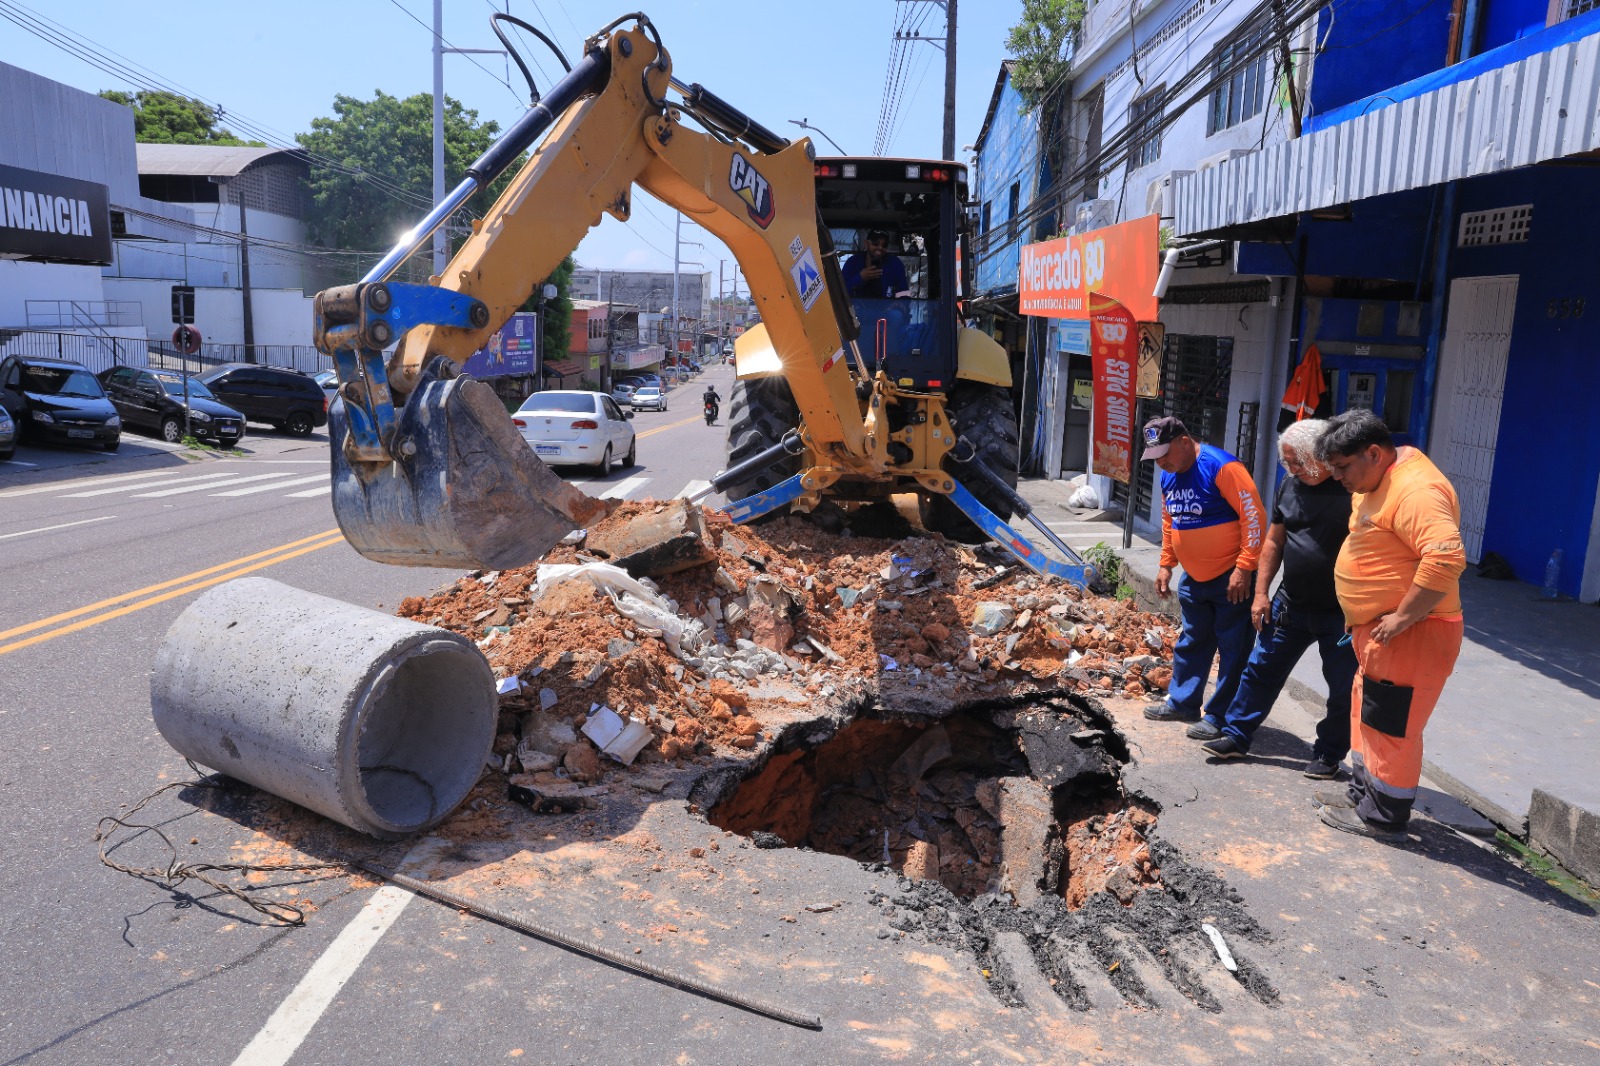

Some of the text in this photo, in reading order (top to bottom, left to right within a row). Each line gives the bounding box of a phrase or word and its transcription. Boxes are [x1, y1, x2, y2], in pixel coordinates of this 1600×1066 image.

[730, 153, 768, 213] CAT
[0, 186, 93, 237] INANCIA
[1023, 235, 1105, 292] Mercado 80
[1096, 315, 1128, 323] MERCADO
[1101, 323, 1128, 342] 80
[1101, 358, 1130, 443] TEMOS PÃES
